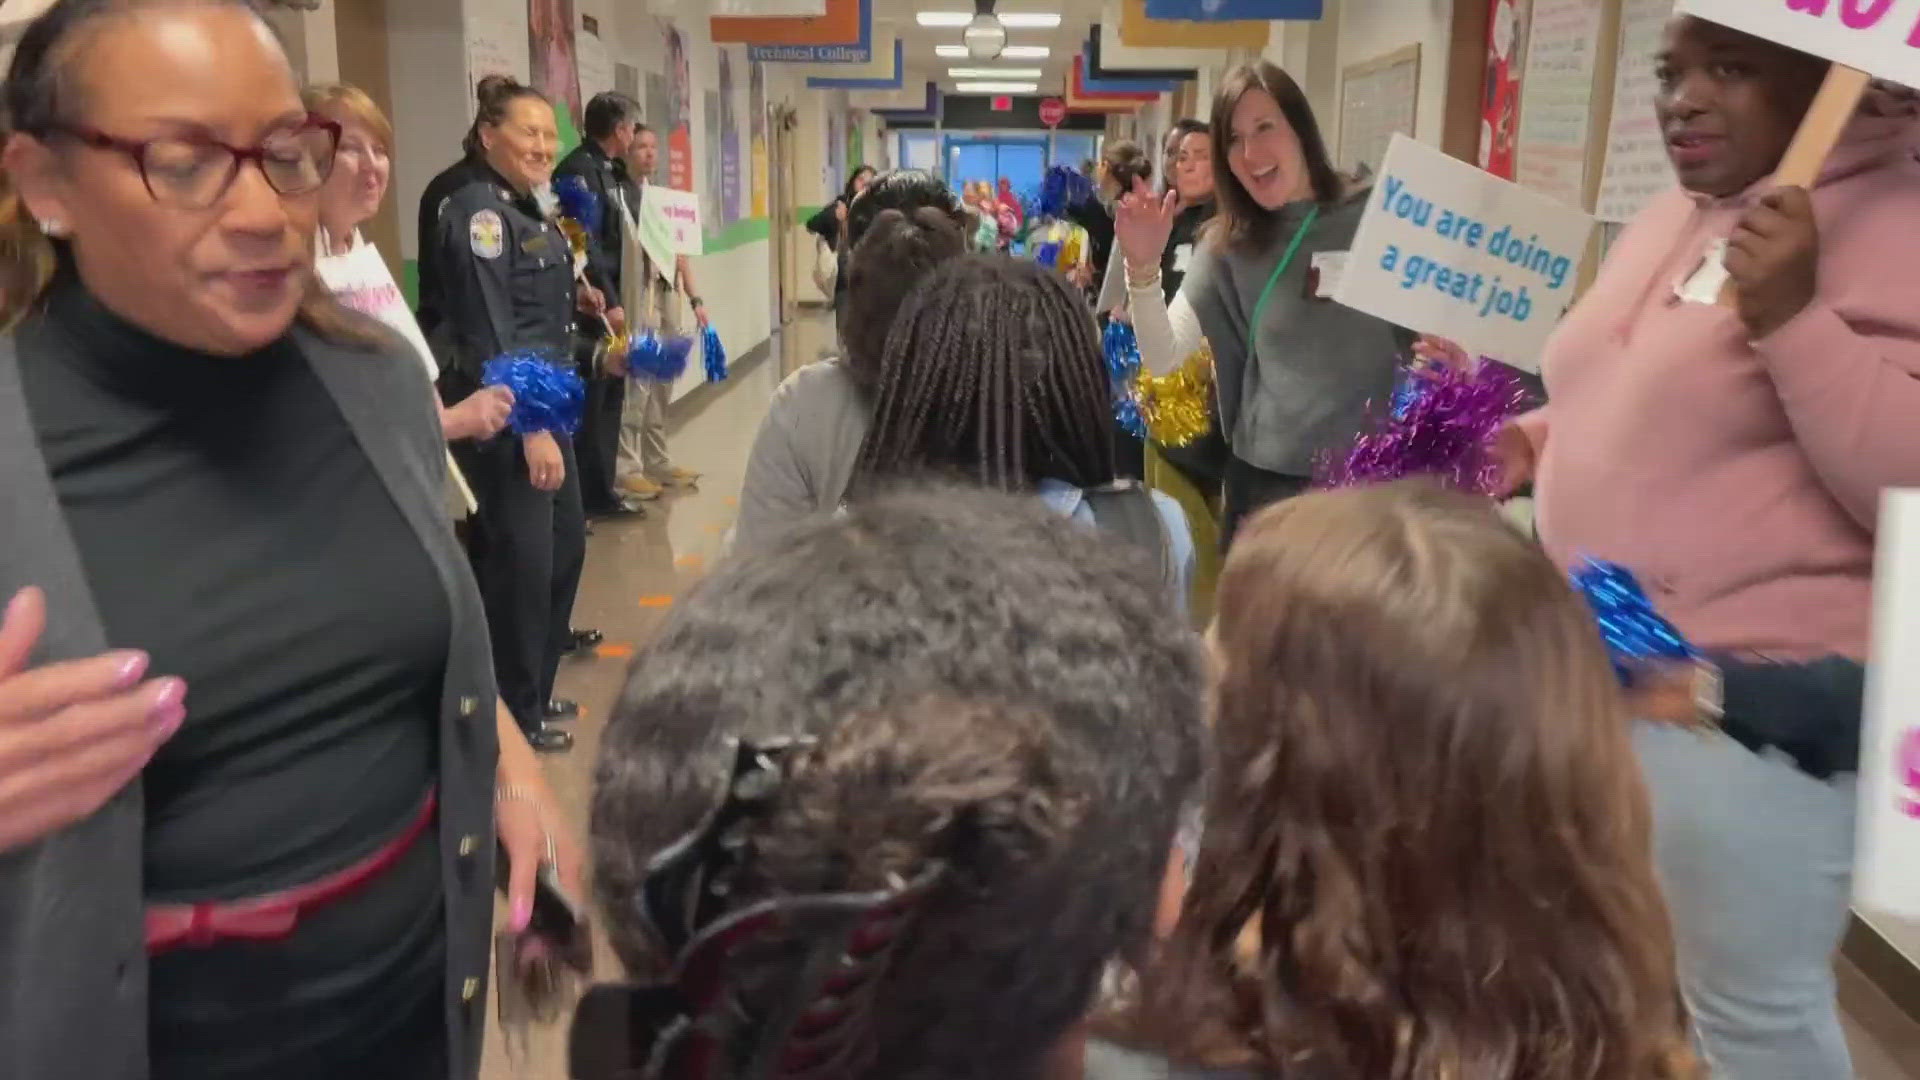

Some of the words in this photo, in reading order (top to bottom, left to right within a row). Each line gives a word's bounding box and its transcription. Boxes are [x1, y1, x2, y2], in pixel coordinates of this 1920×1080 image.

[754, 46, 814, 60] Technical
[818, 46, 868, 62] College
[1382, 175, 1433, 228] You
[1435, 209, 1484, 248] are
[1487, 224, 1571, 289] doing
[1379, 244, 1399, 273] a
[1401, 254, 1484, 304] great
[1479, 277, 1533, 322] job
